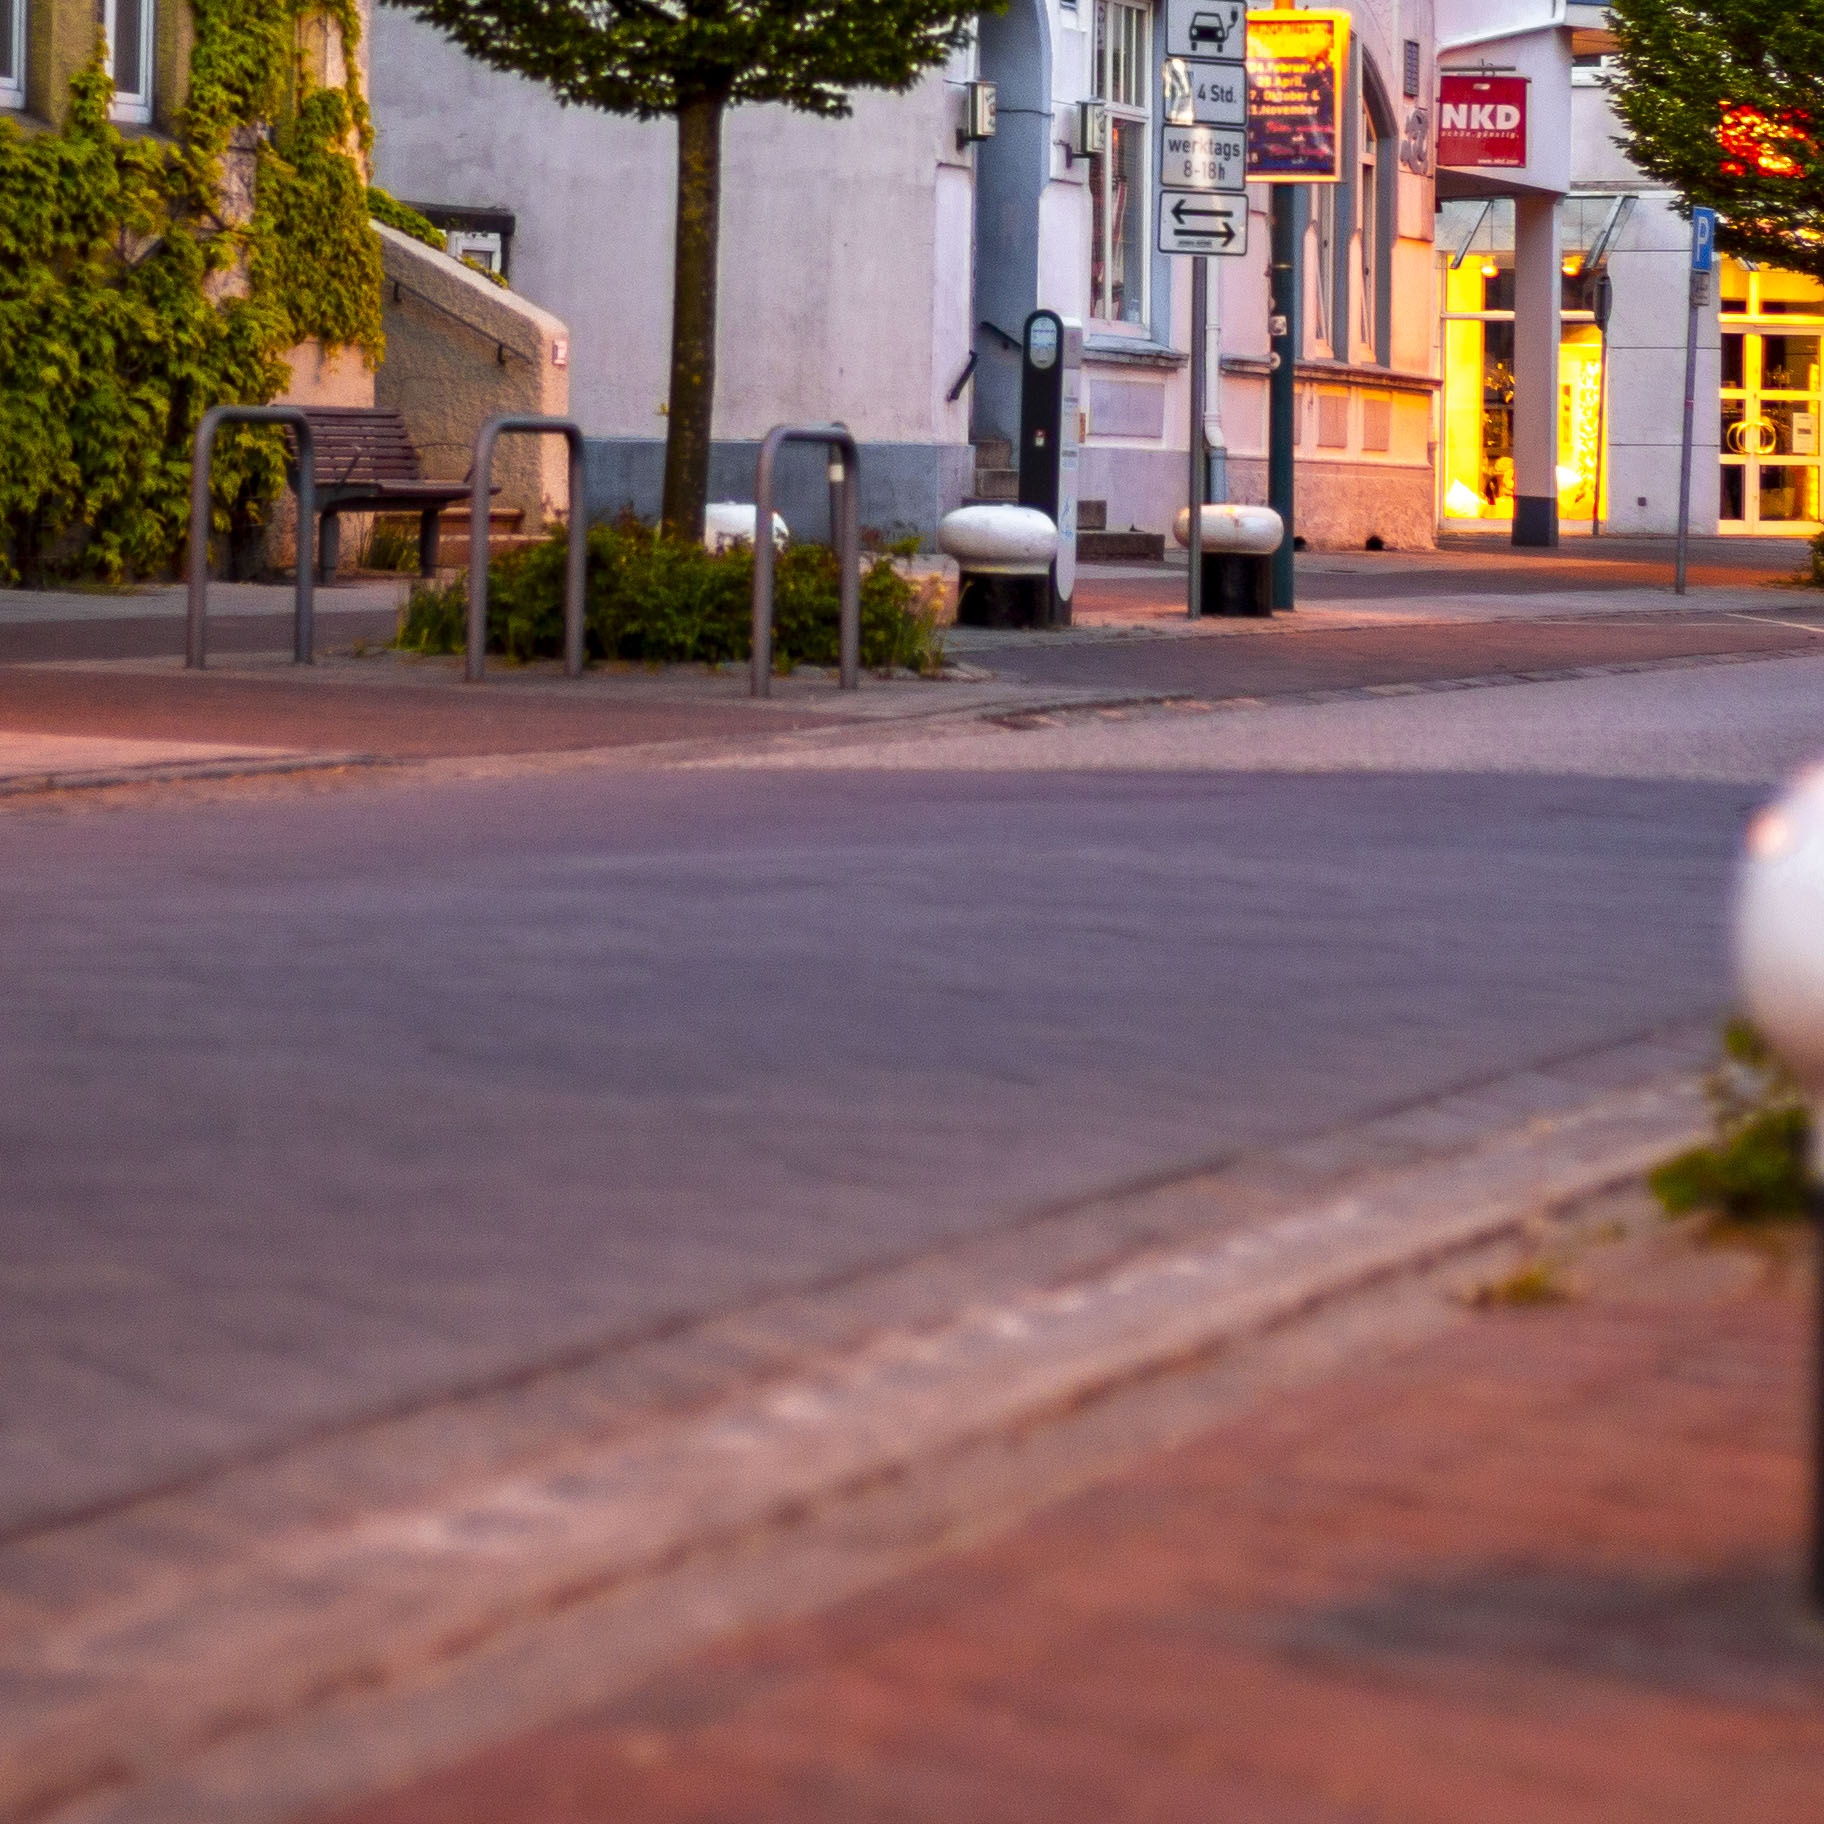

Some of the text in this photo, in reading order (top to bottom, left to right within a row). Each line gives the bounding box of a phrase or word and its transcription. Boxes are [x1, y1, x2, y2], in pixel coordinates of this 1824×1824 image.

[1197, 84, 1237, 104] 4 Std.
[1441, 103, 1521, 130] NKD
[1168, 137, 1241, 162] werktags
[1696, 216, 1710, 263] P
